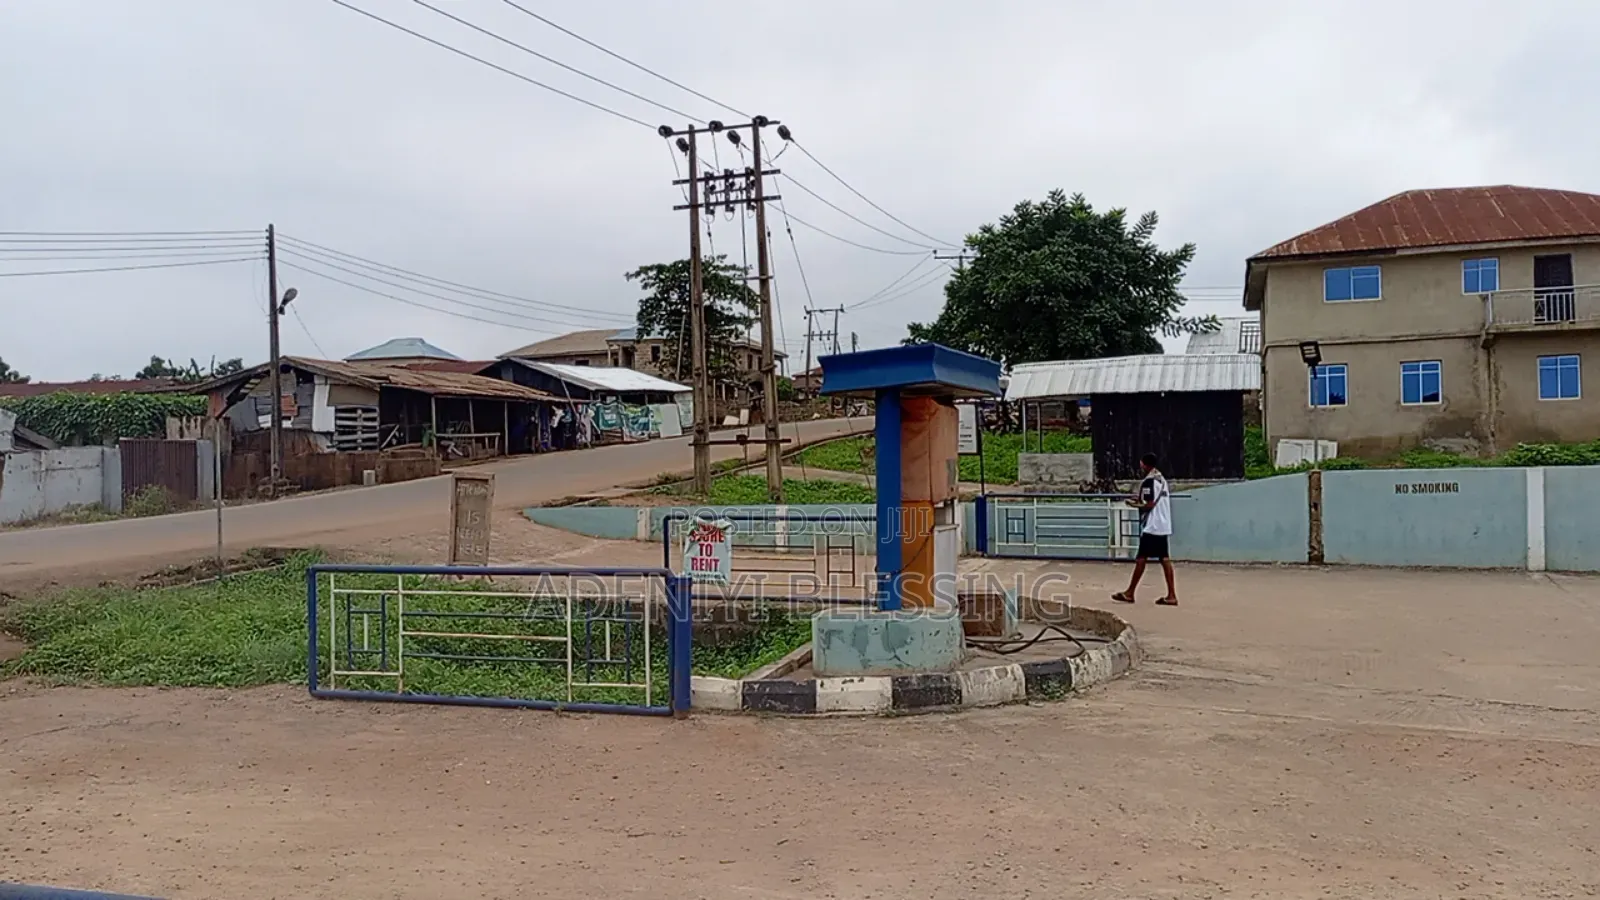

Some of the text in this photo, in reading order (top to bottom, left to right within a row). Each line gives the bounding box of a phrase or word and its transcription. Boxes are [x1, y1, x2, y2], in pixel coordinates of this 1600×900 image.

[1395, 482, 1459, 494] NO SMOKING
[699, 543, 713, 557] TO
[691, 557, 720, 572] RENT
